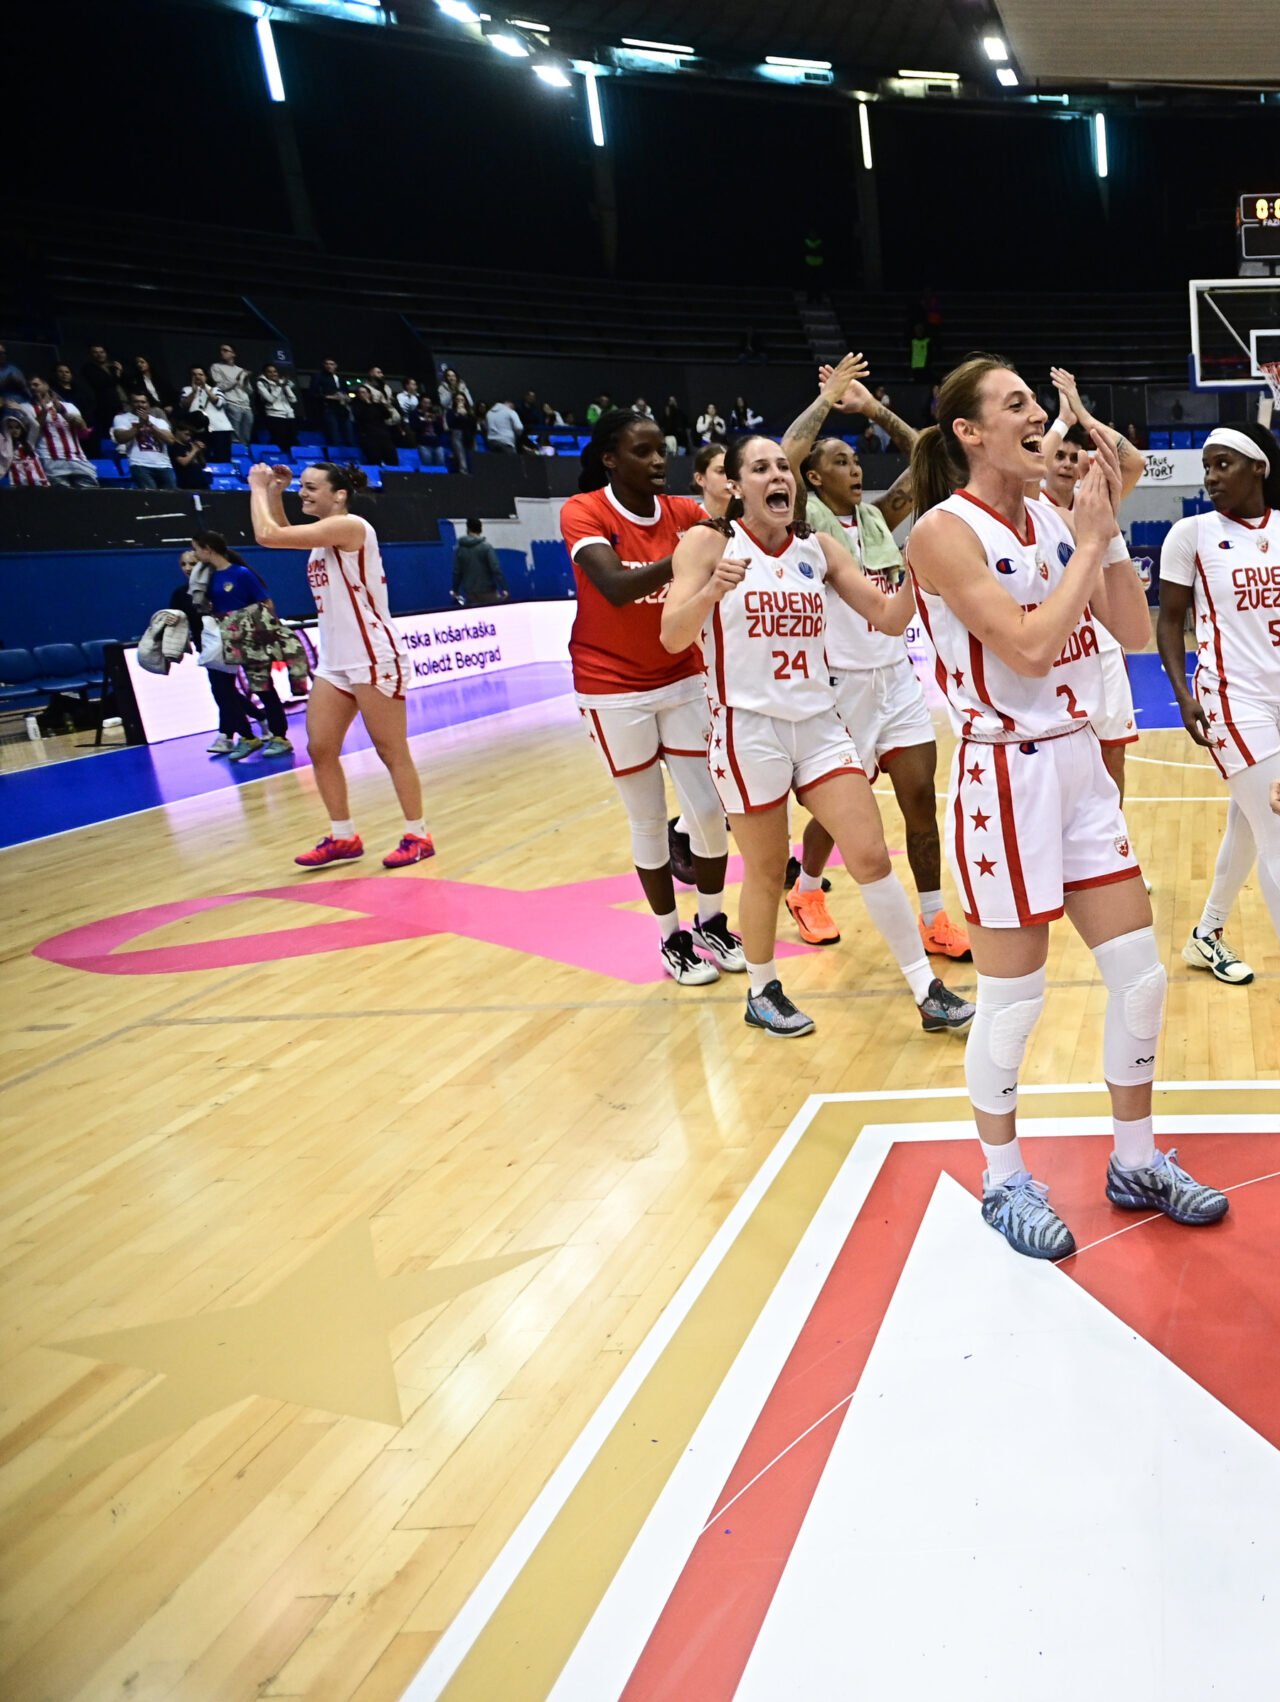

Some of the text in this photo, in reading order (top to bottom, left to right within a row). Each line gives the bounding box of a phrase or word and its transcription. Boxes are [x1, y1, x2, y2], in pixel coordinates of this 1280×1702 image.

[276, 350, 286, 361] 5
[1143, 464, 1175, 478] STORY
[1148, 455, 1168, 466] TRUE
[744, 590, 824, 614] CRVENA
[434, 621, 497, 645] košarkaška
[746, 615, 823, 638] ZVEZDA
[413, 646, 502, 677] koledž Beograd
[771, 650, 810, 680] 24
[1056, 683, 1089, 719] 2
